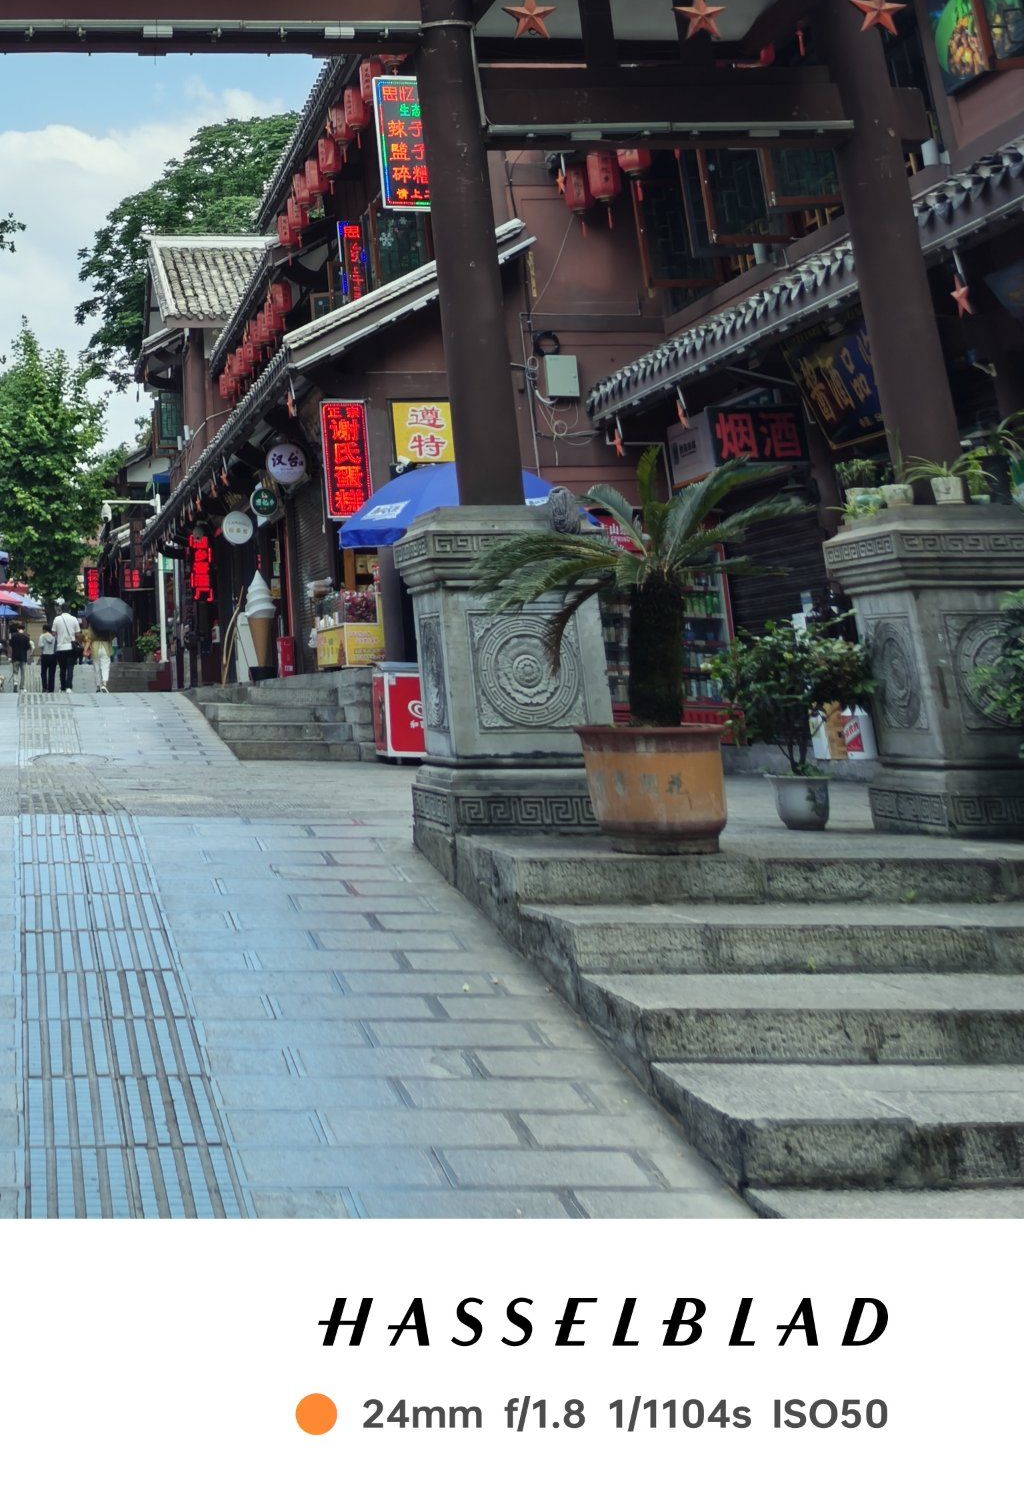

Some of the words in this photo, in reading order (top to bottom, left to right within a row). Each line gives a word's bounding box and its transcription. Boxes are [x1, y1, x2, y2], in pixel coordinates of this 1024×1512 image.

[381, 86, 419, 102] 思忆
[387, 120, 423, 138] 辣子
[328, 406, 360, 418] 正宗
[407, 406, 445, 428] 遵
[409, 434, 446, 457] 特
[714, 410, 802, 461] 烟酒
[329, 419, 364, 513] 谢氏蛋糕
